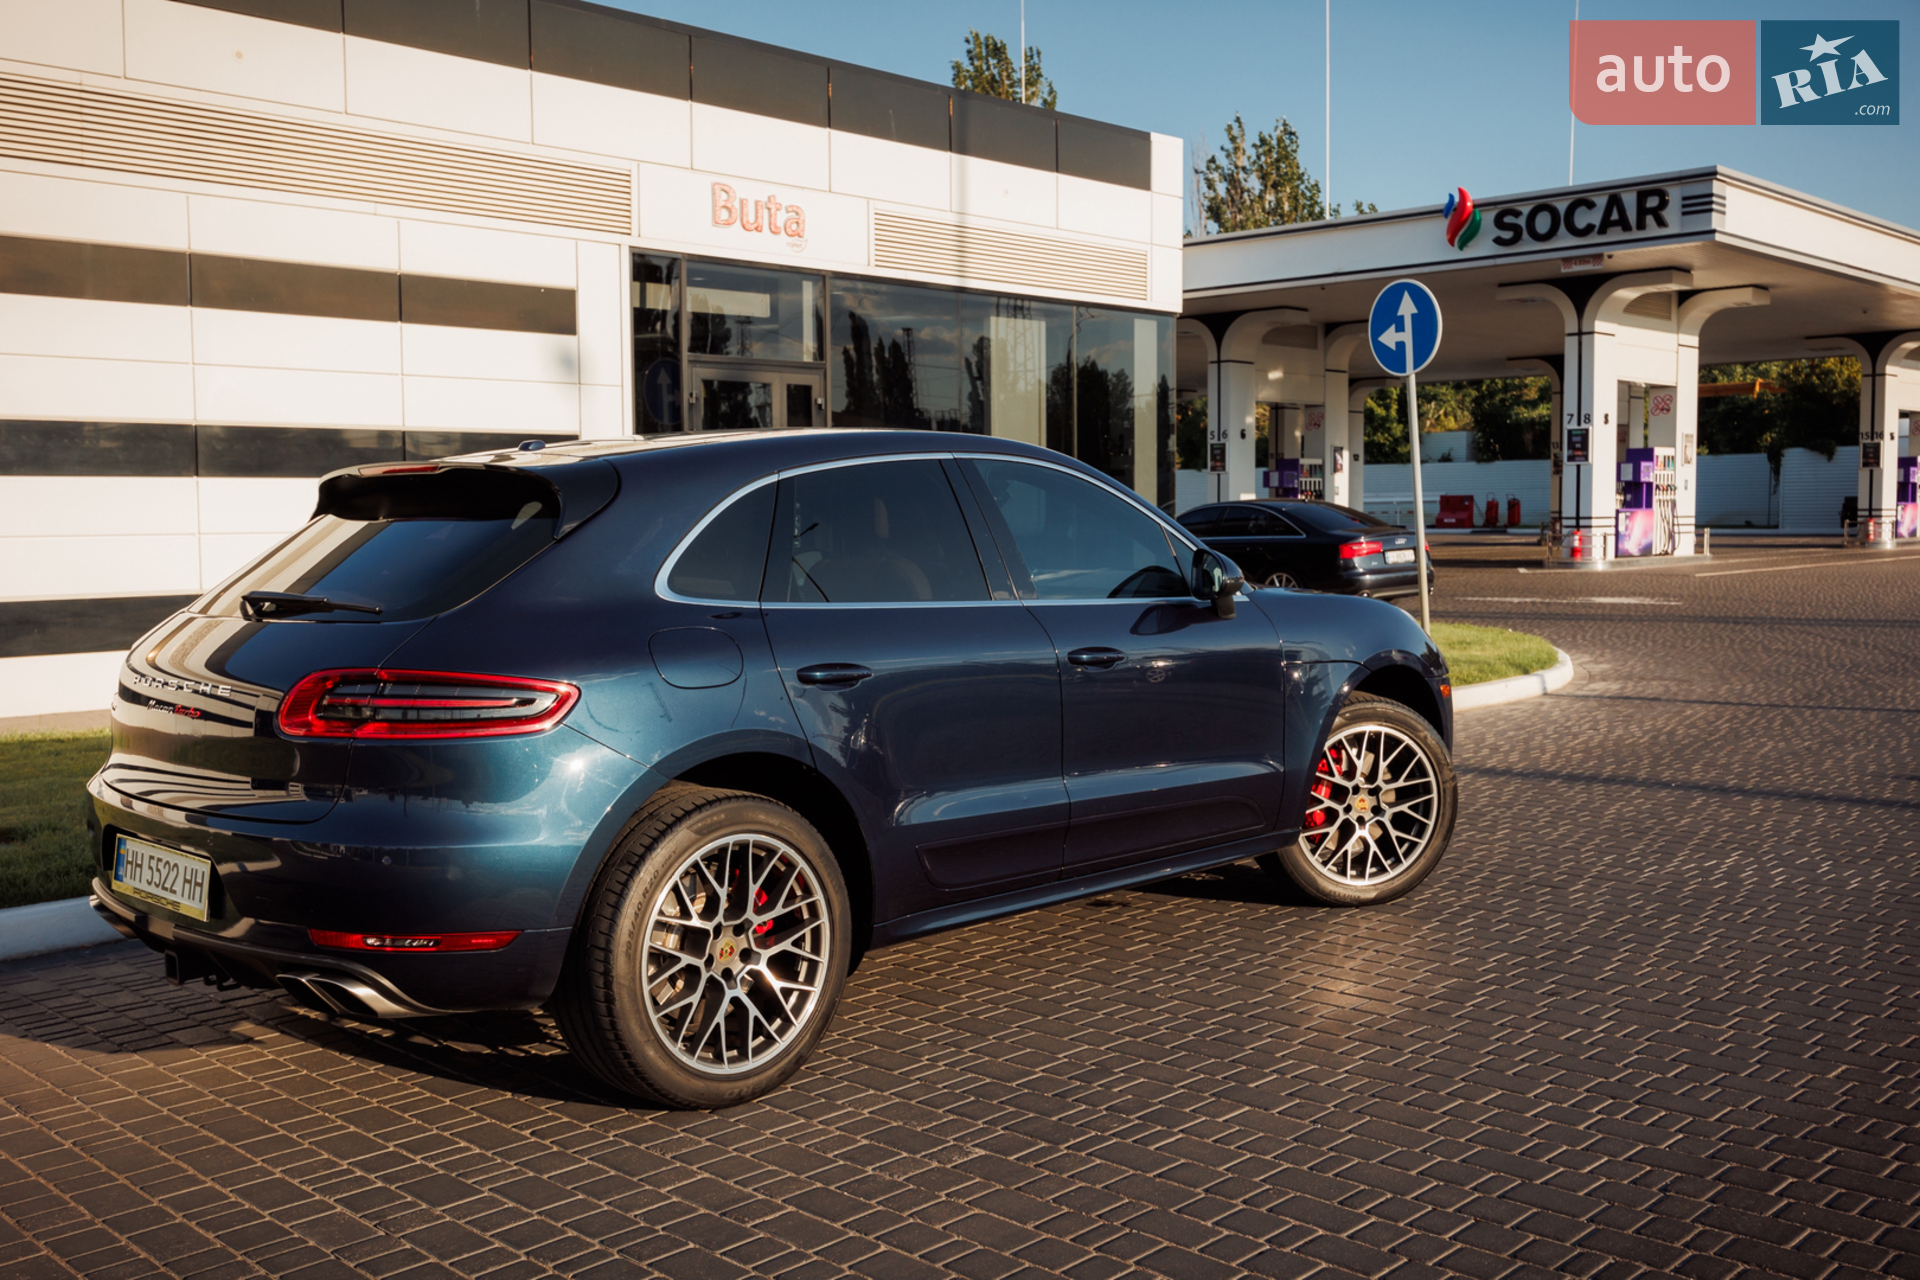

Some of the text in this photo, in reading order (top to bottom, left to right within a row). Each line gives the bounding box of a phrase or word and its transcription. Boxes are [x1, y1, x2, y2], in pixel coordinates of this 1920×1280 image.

[711, 181, 806, 239] Buta
[1492, 187, 1670, 247] SOCAR
[1566, 412, 1591, 424] 7 8
[1222, 429, 1228, 440] 6
[133, 674, 232, 697] PORSCHE
[124, 847, 206, 904] HH 5522 HH
[133, 887, 181, 911] PORSCHE
